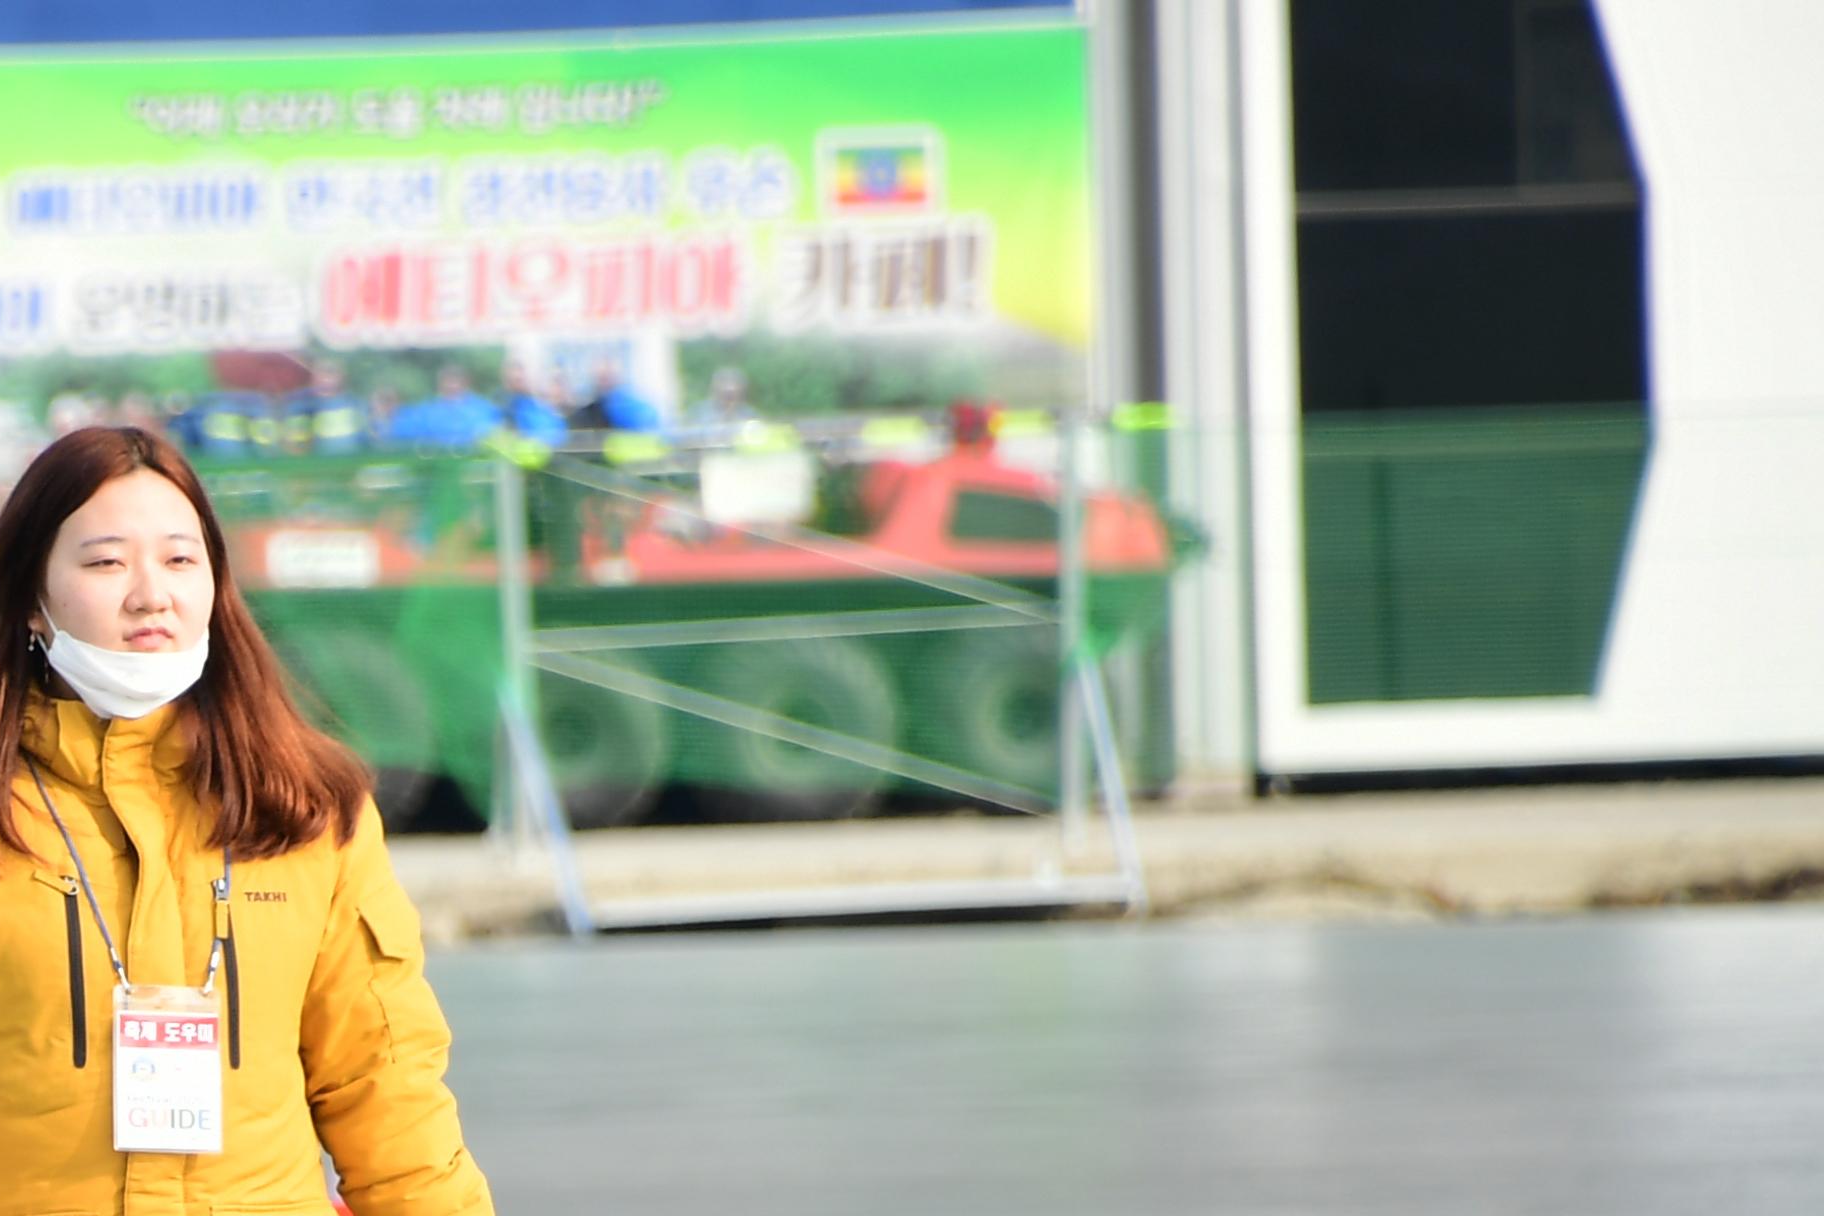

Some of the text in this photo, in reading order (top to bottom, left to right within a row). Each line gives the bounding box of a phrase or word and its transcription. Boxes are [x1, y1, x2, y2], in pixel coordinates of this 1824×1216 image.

[324, 242, 738, 328] 에티오피아
[164, 1022, 215, 1043] 도우미
[128, 1106, 212, 1131] GUIDE
